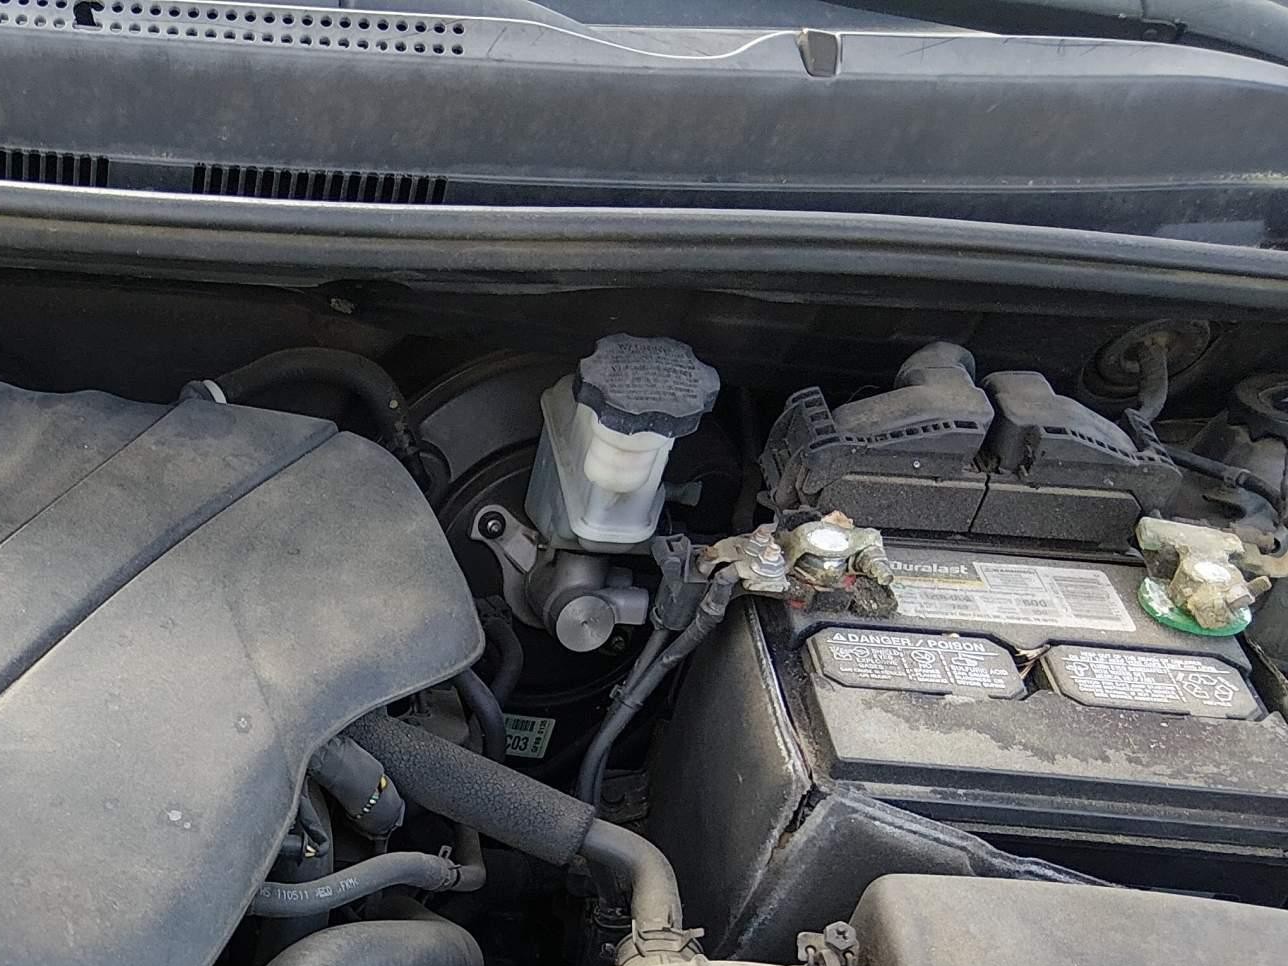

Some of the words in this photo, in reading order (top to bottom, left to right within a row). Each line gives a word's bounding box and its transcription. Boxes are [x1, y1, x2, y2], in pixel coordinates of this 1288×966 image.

[890, 561, 969, 575] Duralast
[847, 633, 912, 647] DANGER
[927, 639, 985, 653] POISON
[277, 888, 310, 901] 110511
